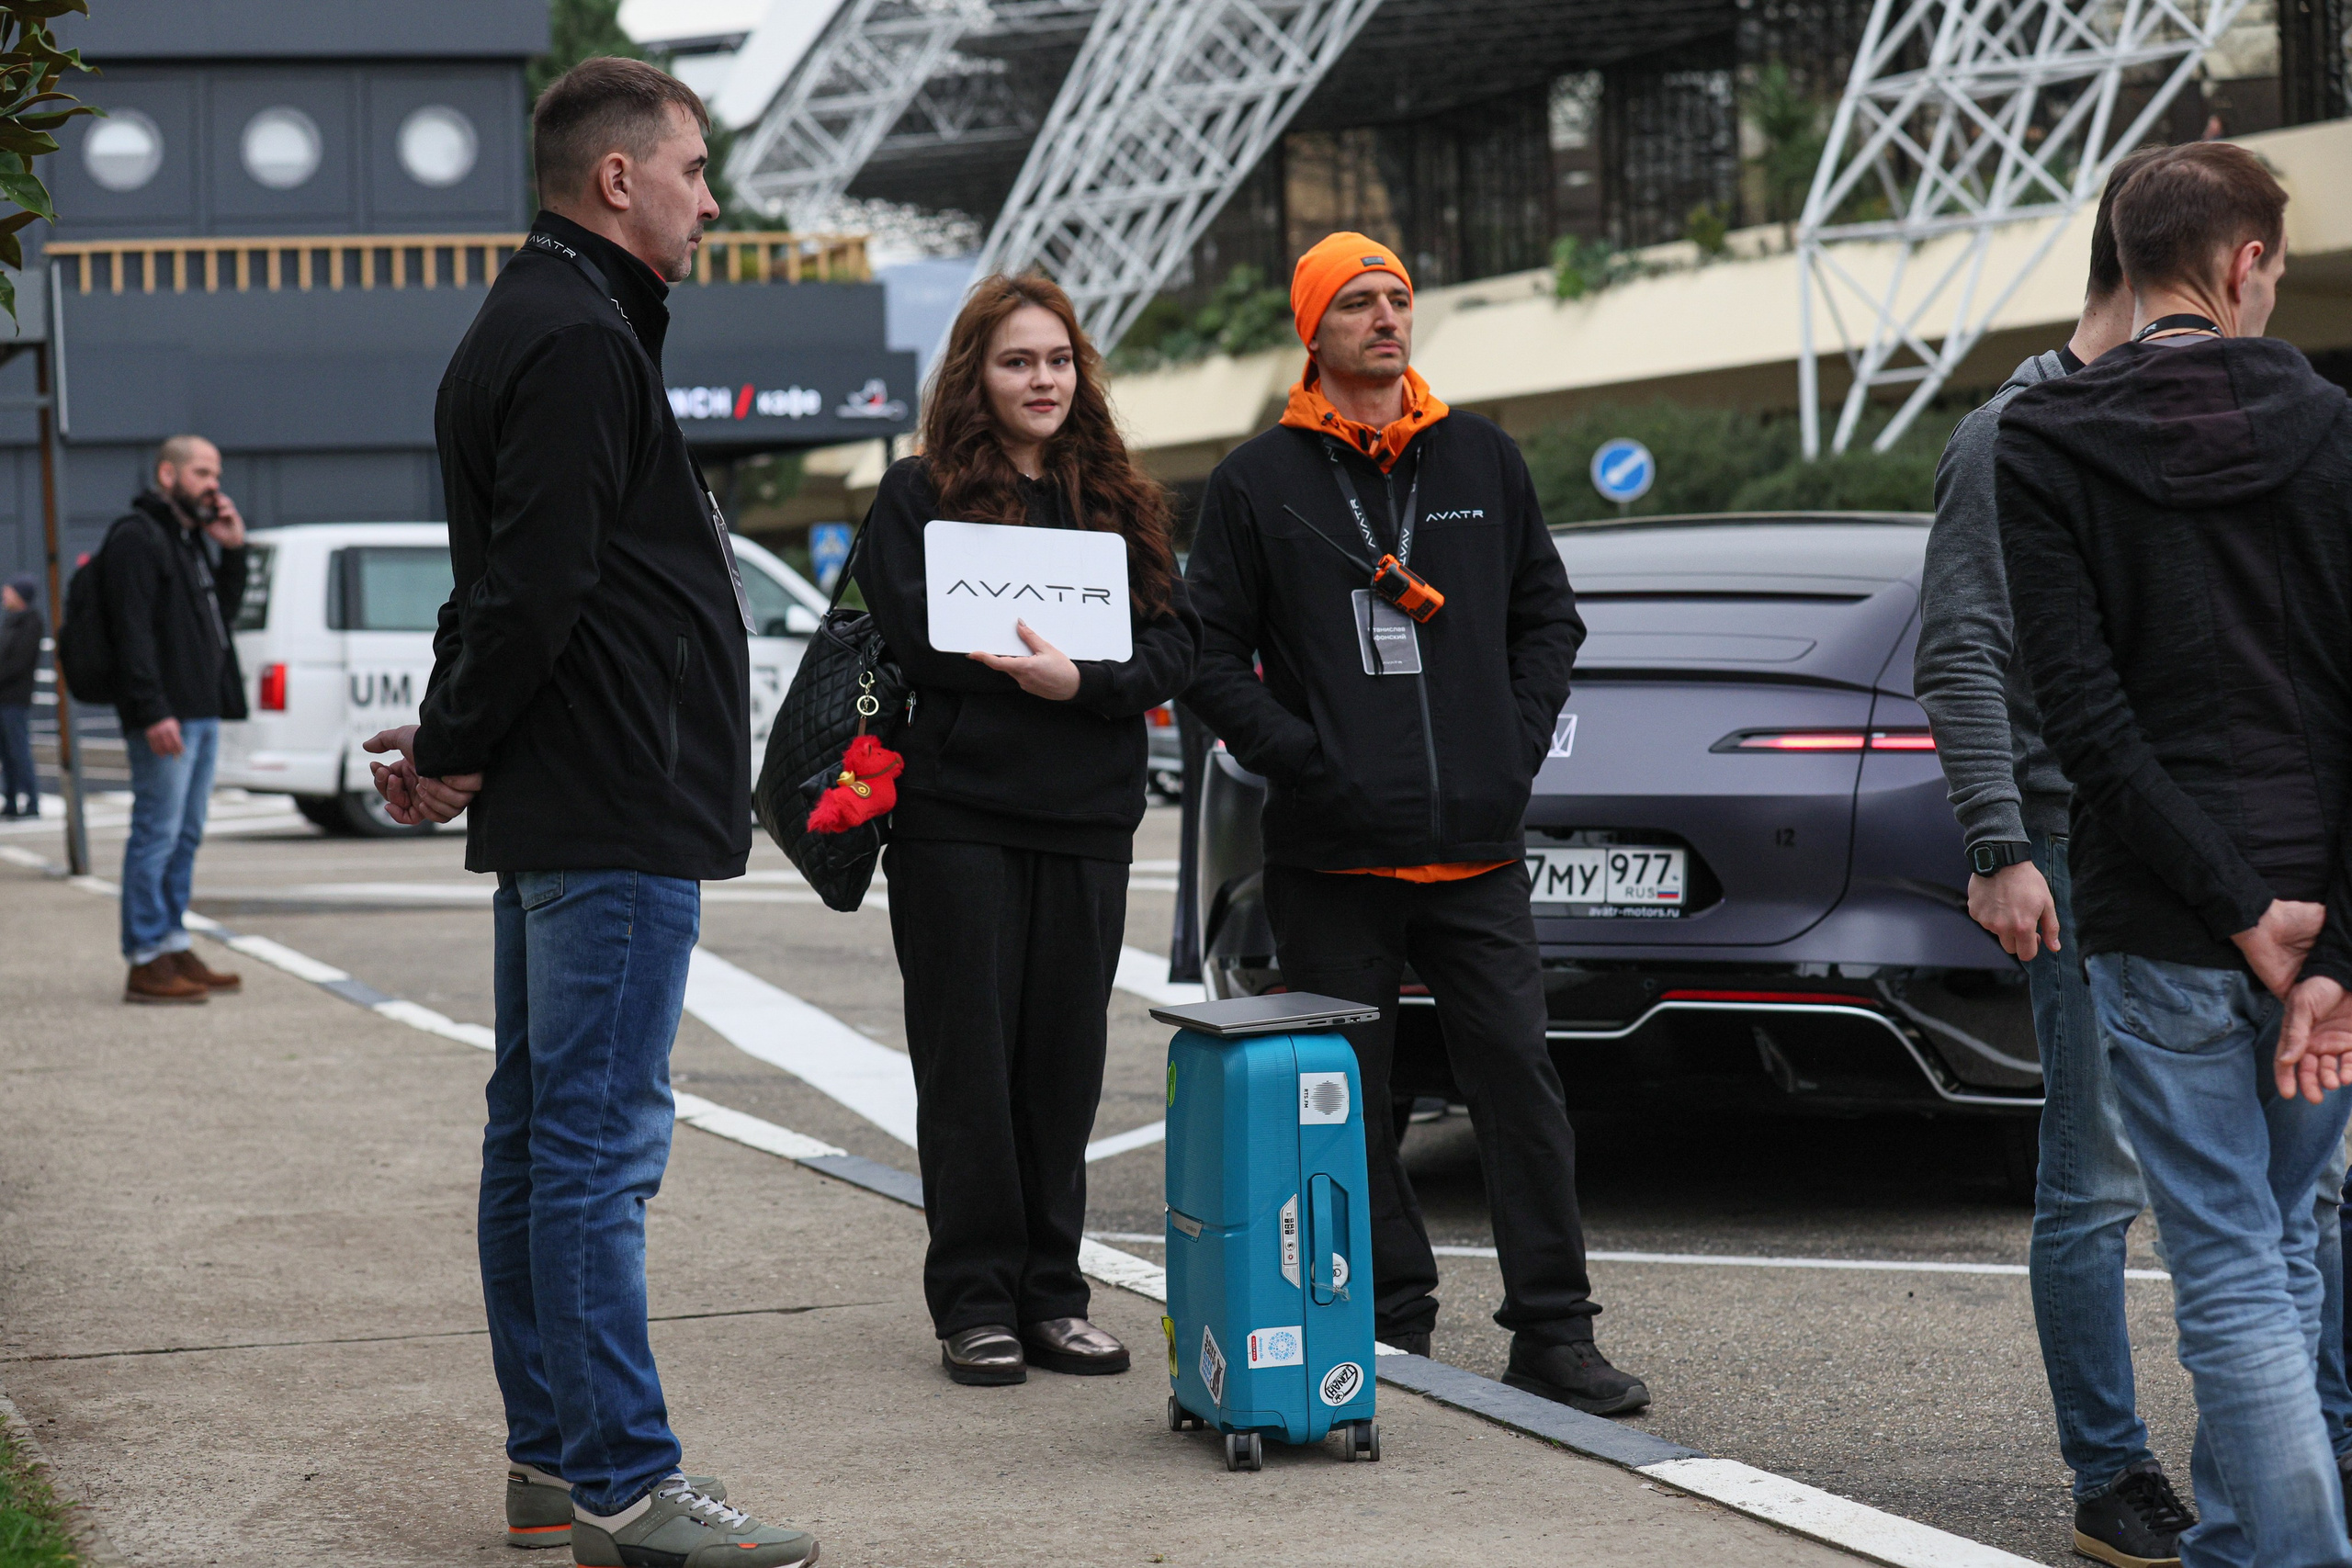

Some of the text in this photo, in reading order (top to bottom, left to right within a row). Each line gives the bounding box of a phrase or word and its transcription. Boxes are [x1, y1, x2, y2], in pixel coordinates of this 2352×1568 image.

[528, 234, 577, 259] AVATR
[664, 386, 732, 420] NCH
[756, 384, 822, 421] кафе
[1349, 498, 1377, 548] AVATR
[1425, 509, 1484, 523] AVATR
[1398, 527, 1410, 567] AVAT
[946, 579, 1112, 606] AVATR
[1373, 633, 1407, 641] фонский
[1610, 852, 1673, 886] 977
[1624, 886, 1656, 898] RUS
[1588, 906, 1680, 919] avatr-motors.ru
